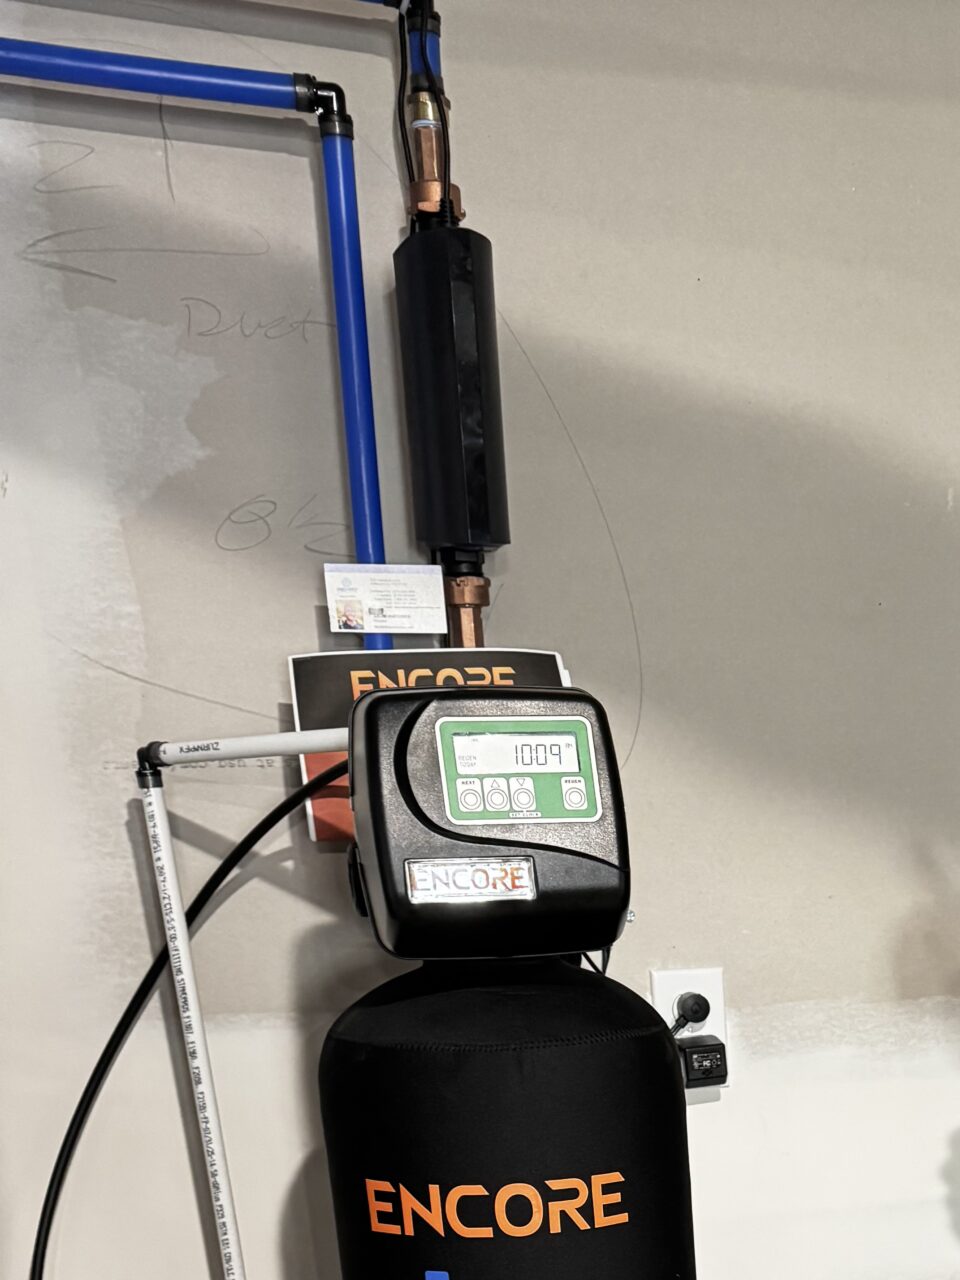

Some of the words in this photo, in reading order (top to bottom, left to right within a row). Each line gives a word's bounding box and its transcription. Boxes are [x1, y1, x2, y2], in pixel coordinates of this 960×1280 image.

[515, 743, 562, 766] 10:09
[410, 866, 528, 892] ENCORE
[365, 1171, 629, 1238] ENCORE
